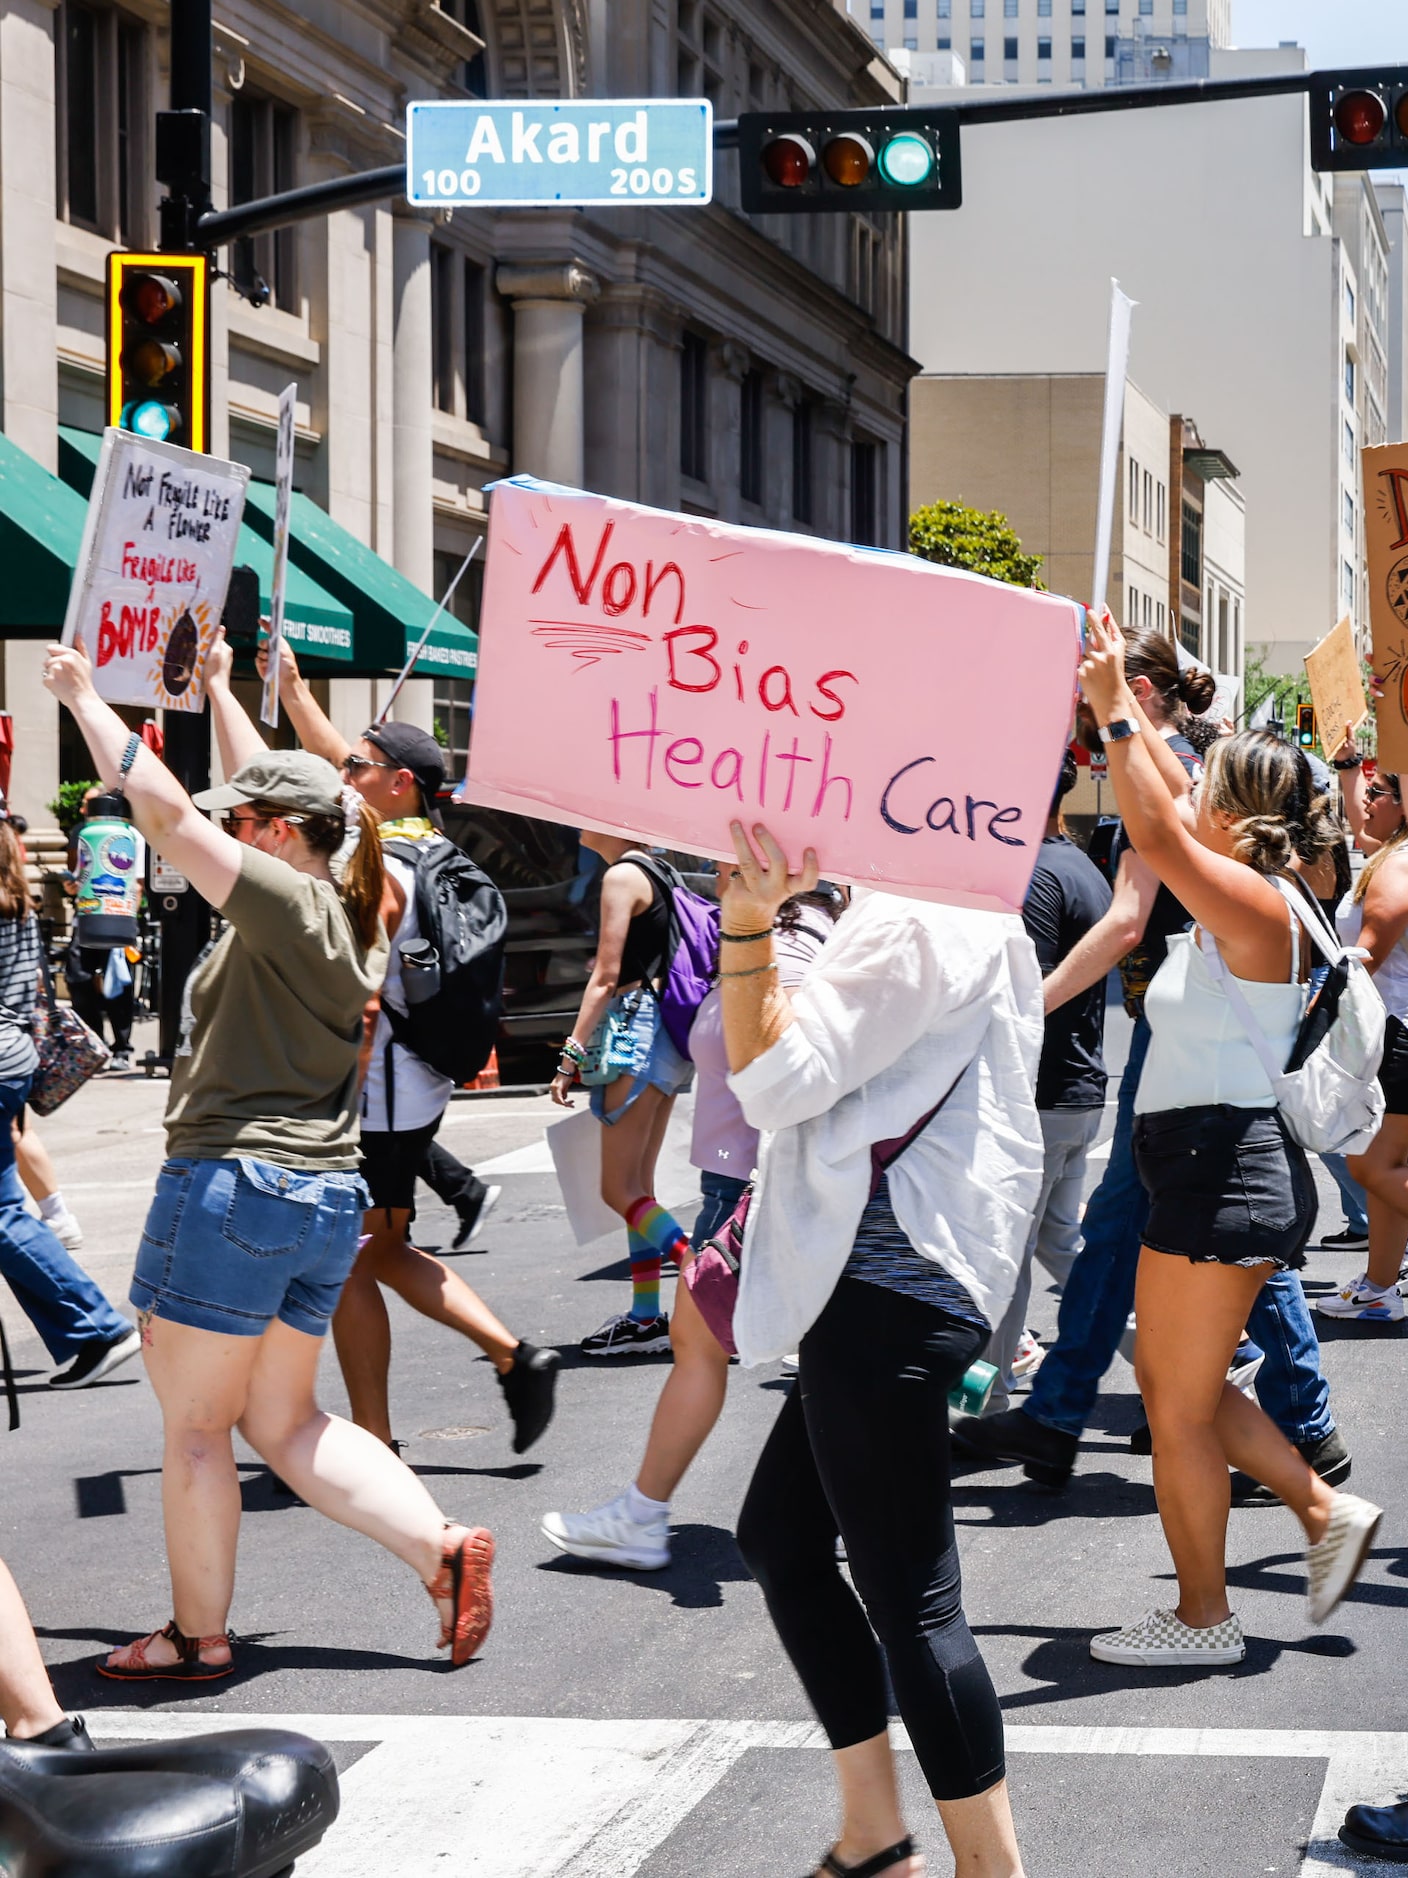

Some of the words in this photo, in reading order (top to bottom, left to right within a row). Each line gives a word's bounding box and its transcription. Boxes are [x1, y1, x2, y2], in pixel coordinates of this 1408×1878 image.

[465, 110, 648, 164] Akard
[422, 169, 481, 196] 100
[143, 507, 154, 531] A
[146, 588, 155, 604] A
[529, 517, 686, 625] Non
[96, 600, 161, 668] BOMB
[306, 623, 352, 649] SMOOTHIES
[662, 624, 859, 722] Bias
[607, 685, 853, 822] Health
[878, 756, 1028, 848] Care
